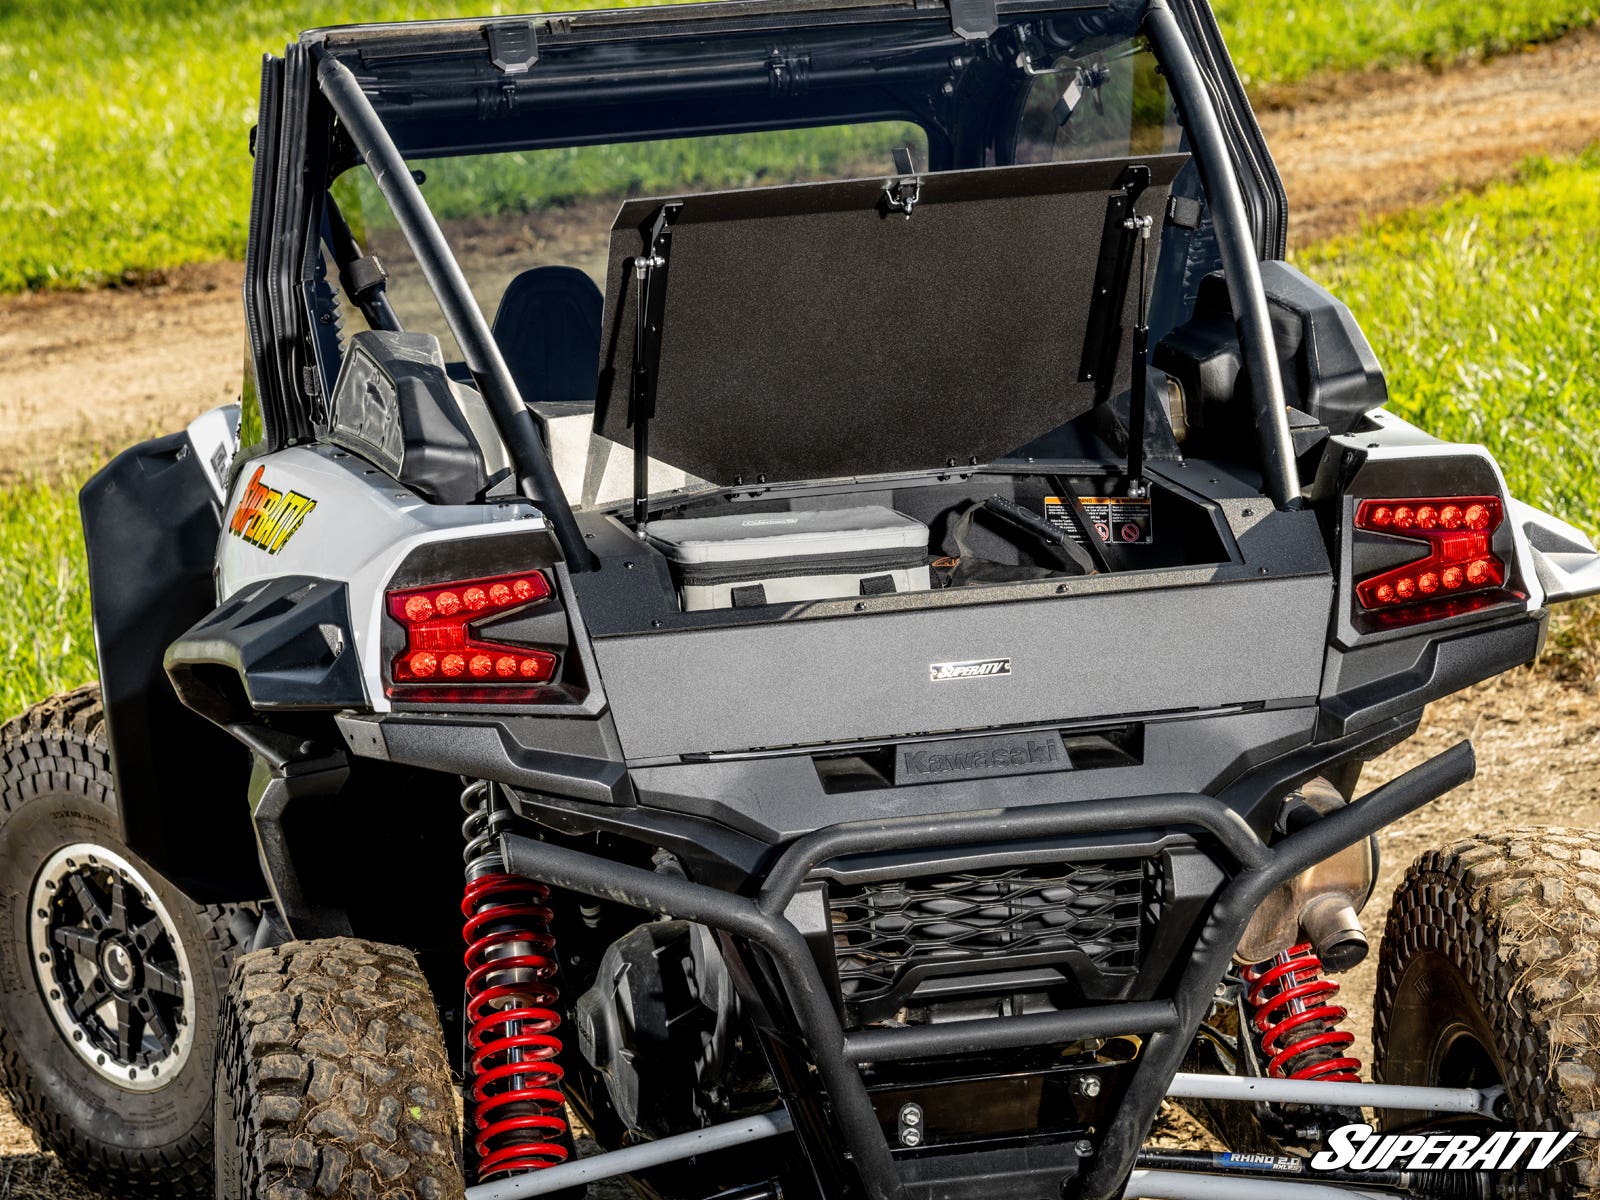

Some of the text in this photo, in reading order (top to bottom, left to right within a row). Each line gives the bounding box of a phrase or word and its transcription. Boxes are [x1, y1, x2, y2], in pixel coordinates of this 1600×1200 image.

[229, 464, 317, 555] SUPERATV
[937, 663, 1003, 678] SUPERATV
[904, 739, 1056, 775] Kawasaki
[1231, 1153, 1300, 1165] RHINO 2.0
